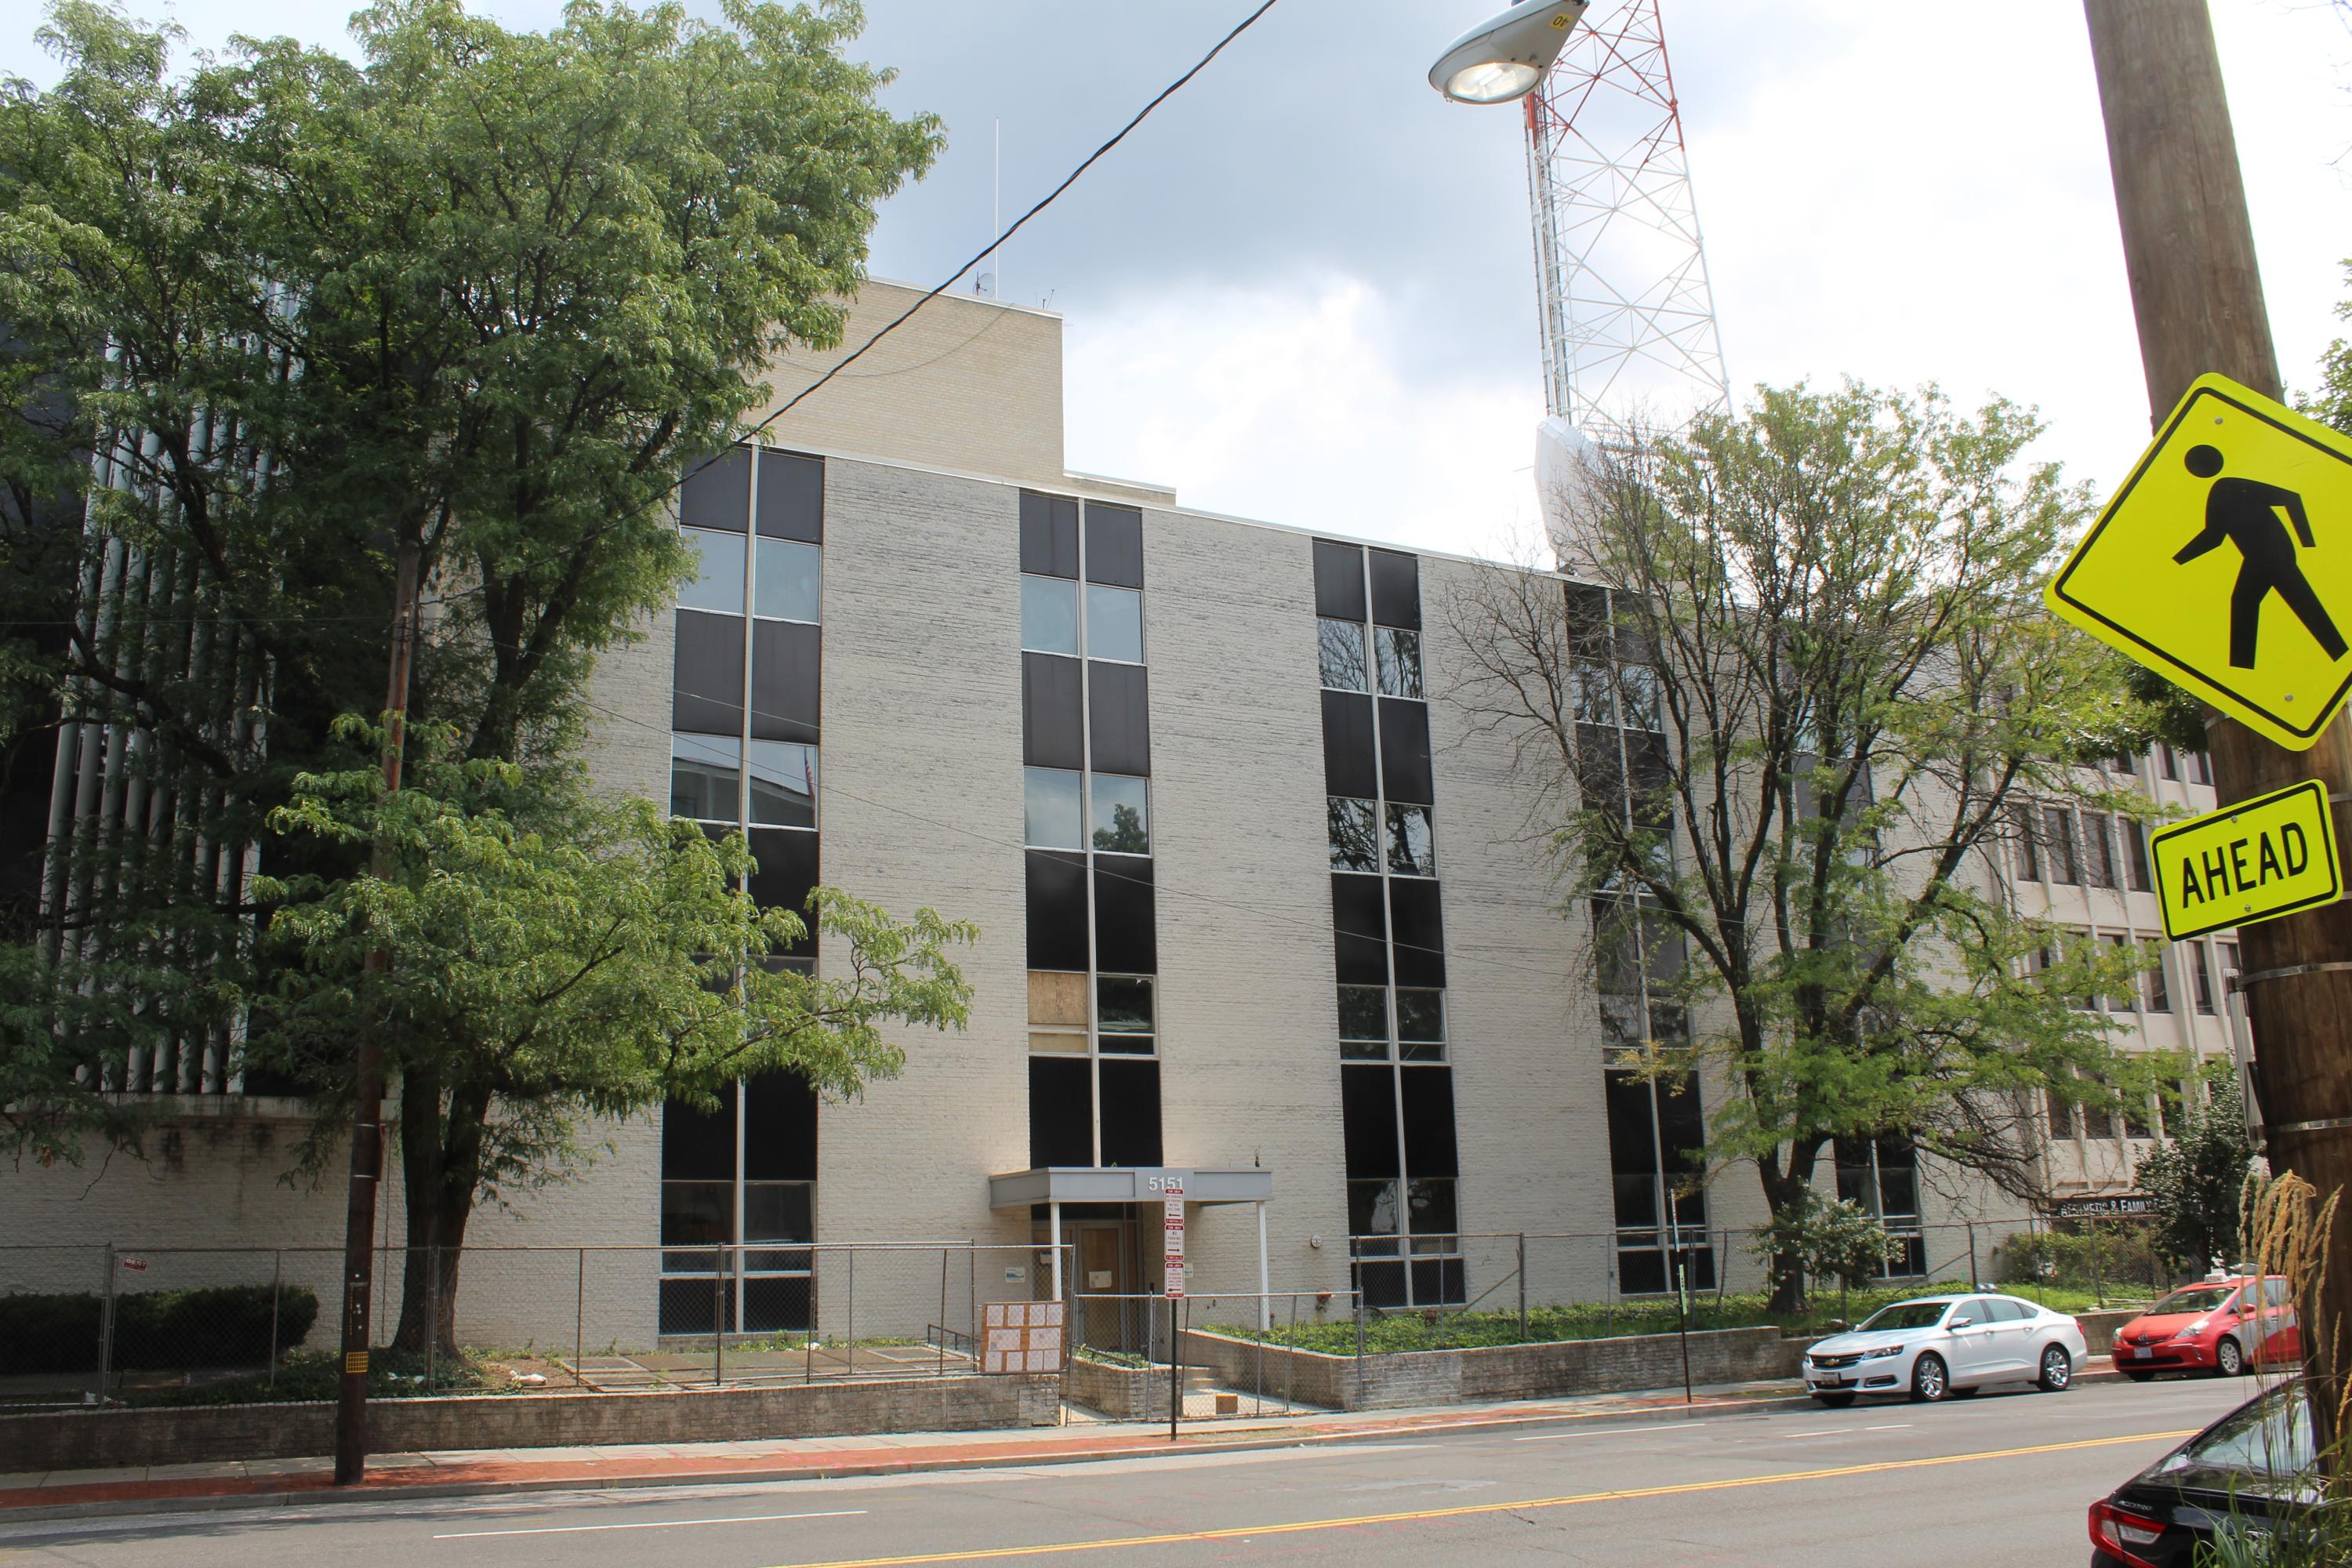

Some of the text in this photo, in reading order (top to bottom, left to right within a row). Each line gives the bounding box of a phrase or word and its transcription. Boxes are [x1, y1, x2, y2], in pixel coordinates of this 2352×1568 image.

[2183, 822, 2308, 909] AHEAD
[1149, 1177, 1182, 1191] 5151
[2118, 1501, 2153, 1511] ACCORD
